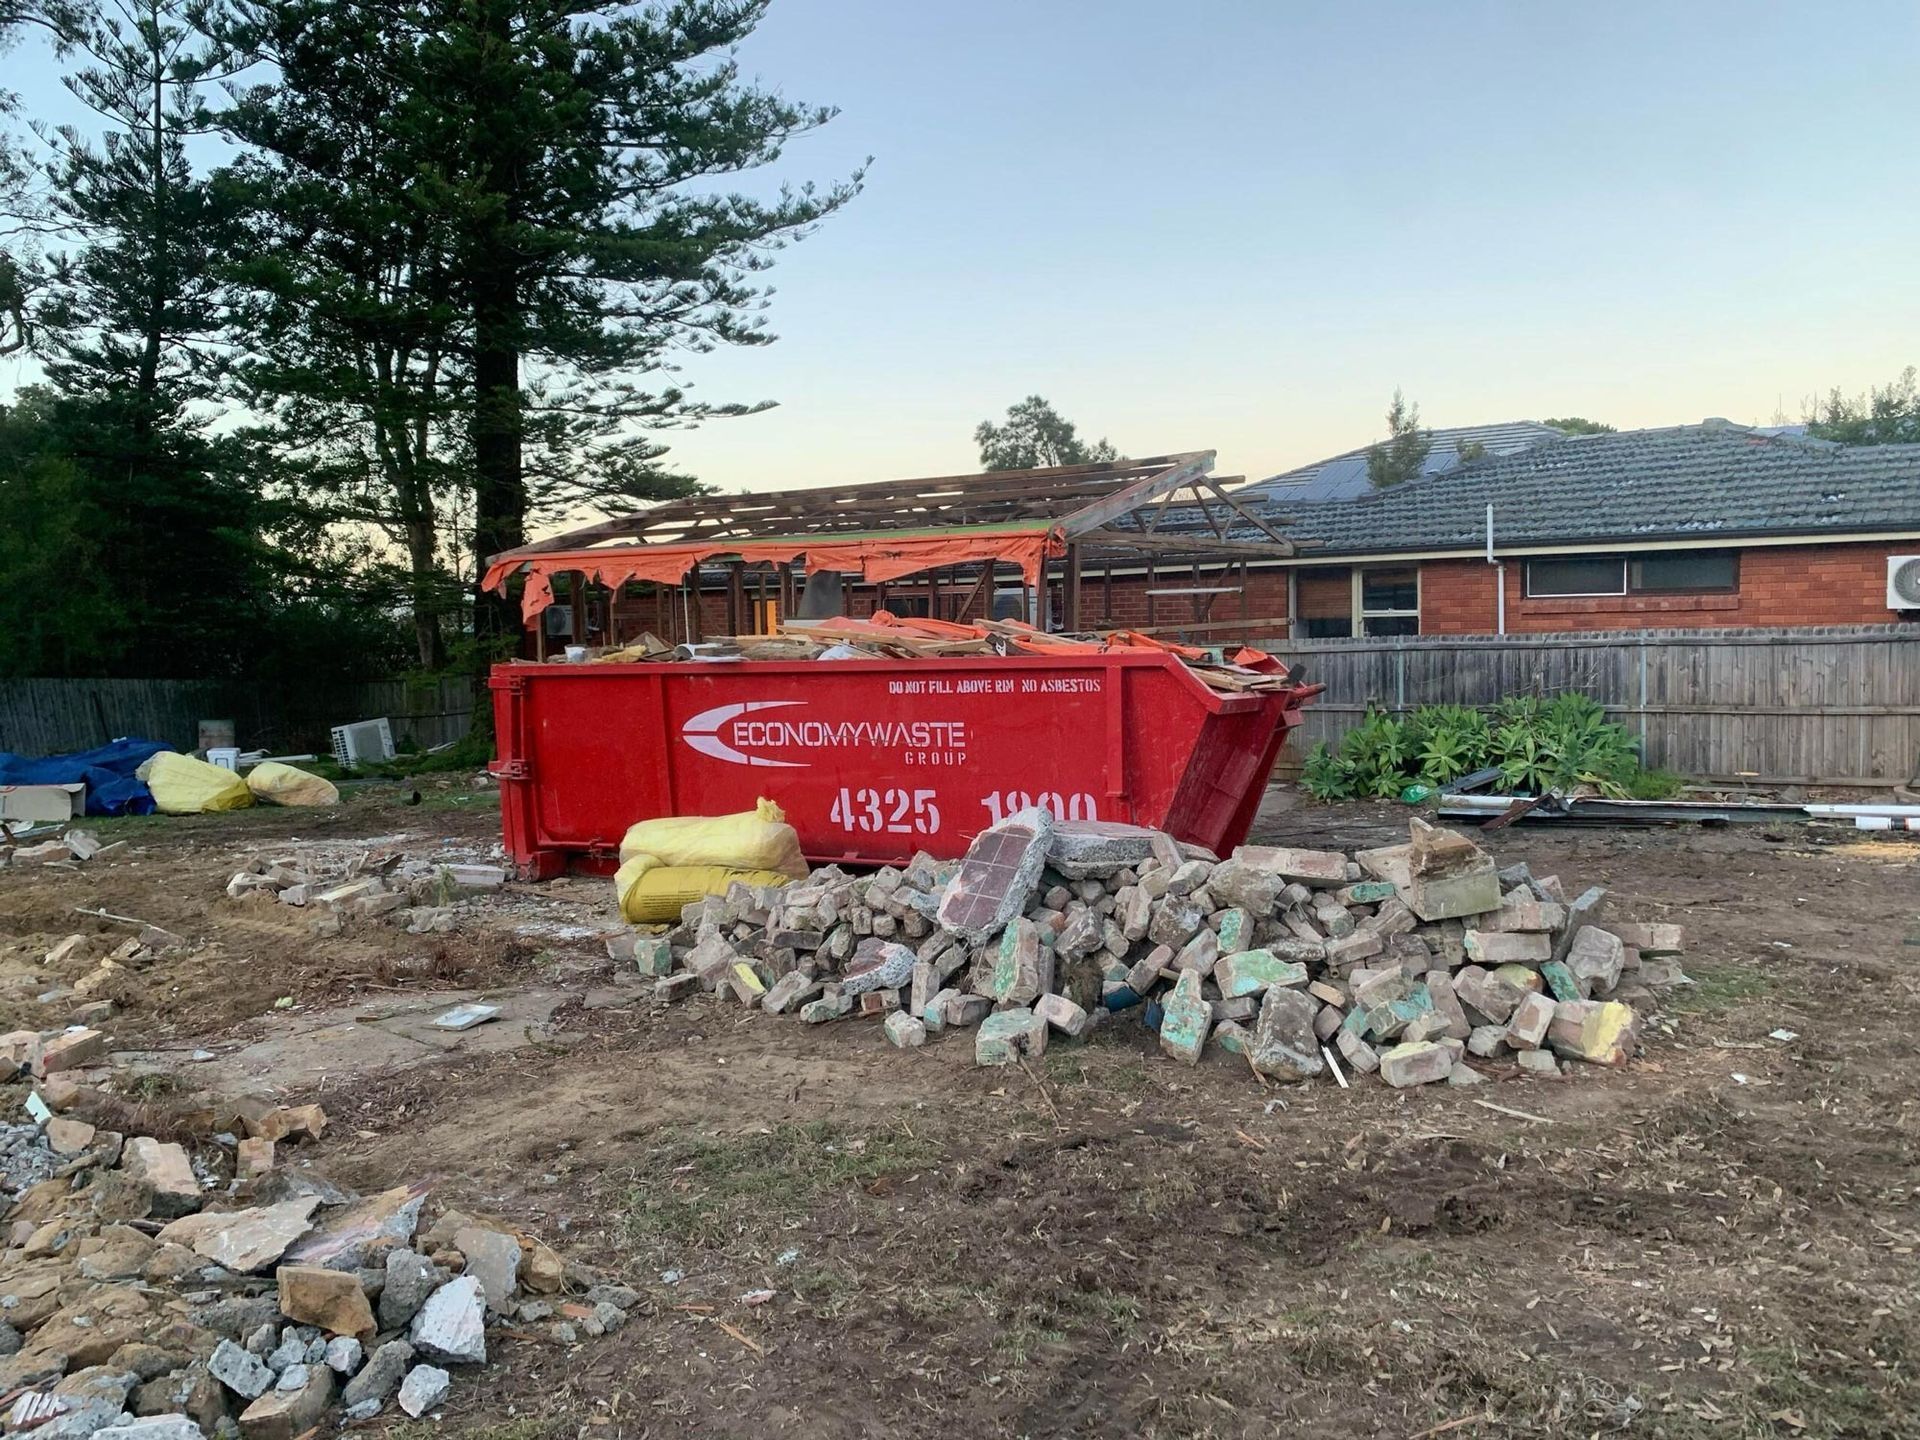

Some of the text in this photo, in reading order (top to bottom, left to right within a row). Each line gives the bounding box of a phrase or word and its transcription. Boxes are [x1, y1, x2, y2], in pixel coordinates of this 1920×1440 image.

[889, 679, 1014, 694] DO NOT FILL ABOVE RIM
[1021, 679, 1101, 693] NO ASBESTOS
[733, 721, 966, 747] ECONOMYWASTE
[905, 752, 967, 766] GROUP
[830, 787, 941, 834] 4325
